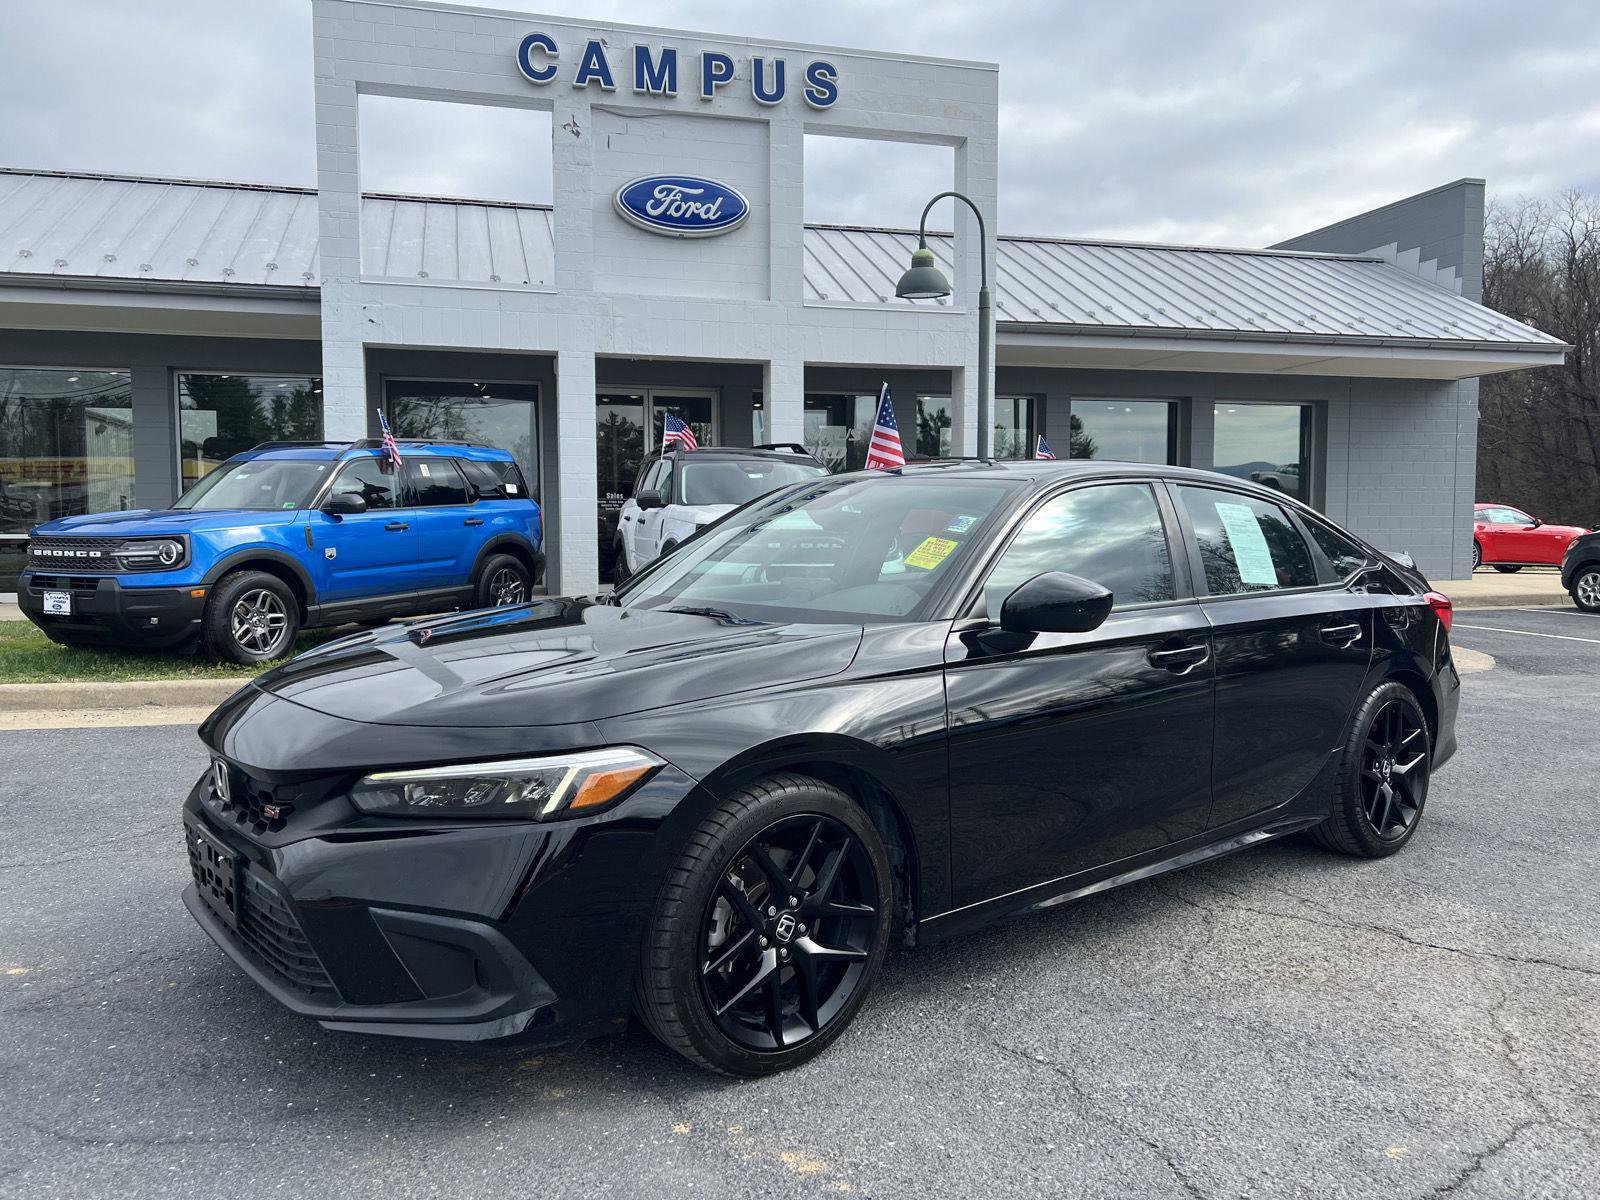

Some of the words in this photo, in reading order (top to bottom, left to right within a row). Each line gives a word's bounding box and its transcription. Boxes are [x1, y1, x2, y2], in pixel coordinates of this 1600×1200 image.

[515, 31, 840, 110] CAMPUS
[645, 183, 724, 221] Ford
[33, 549, 102, 557] BRONCO
